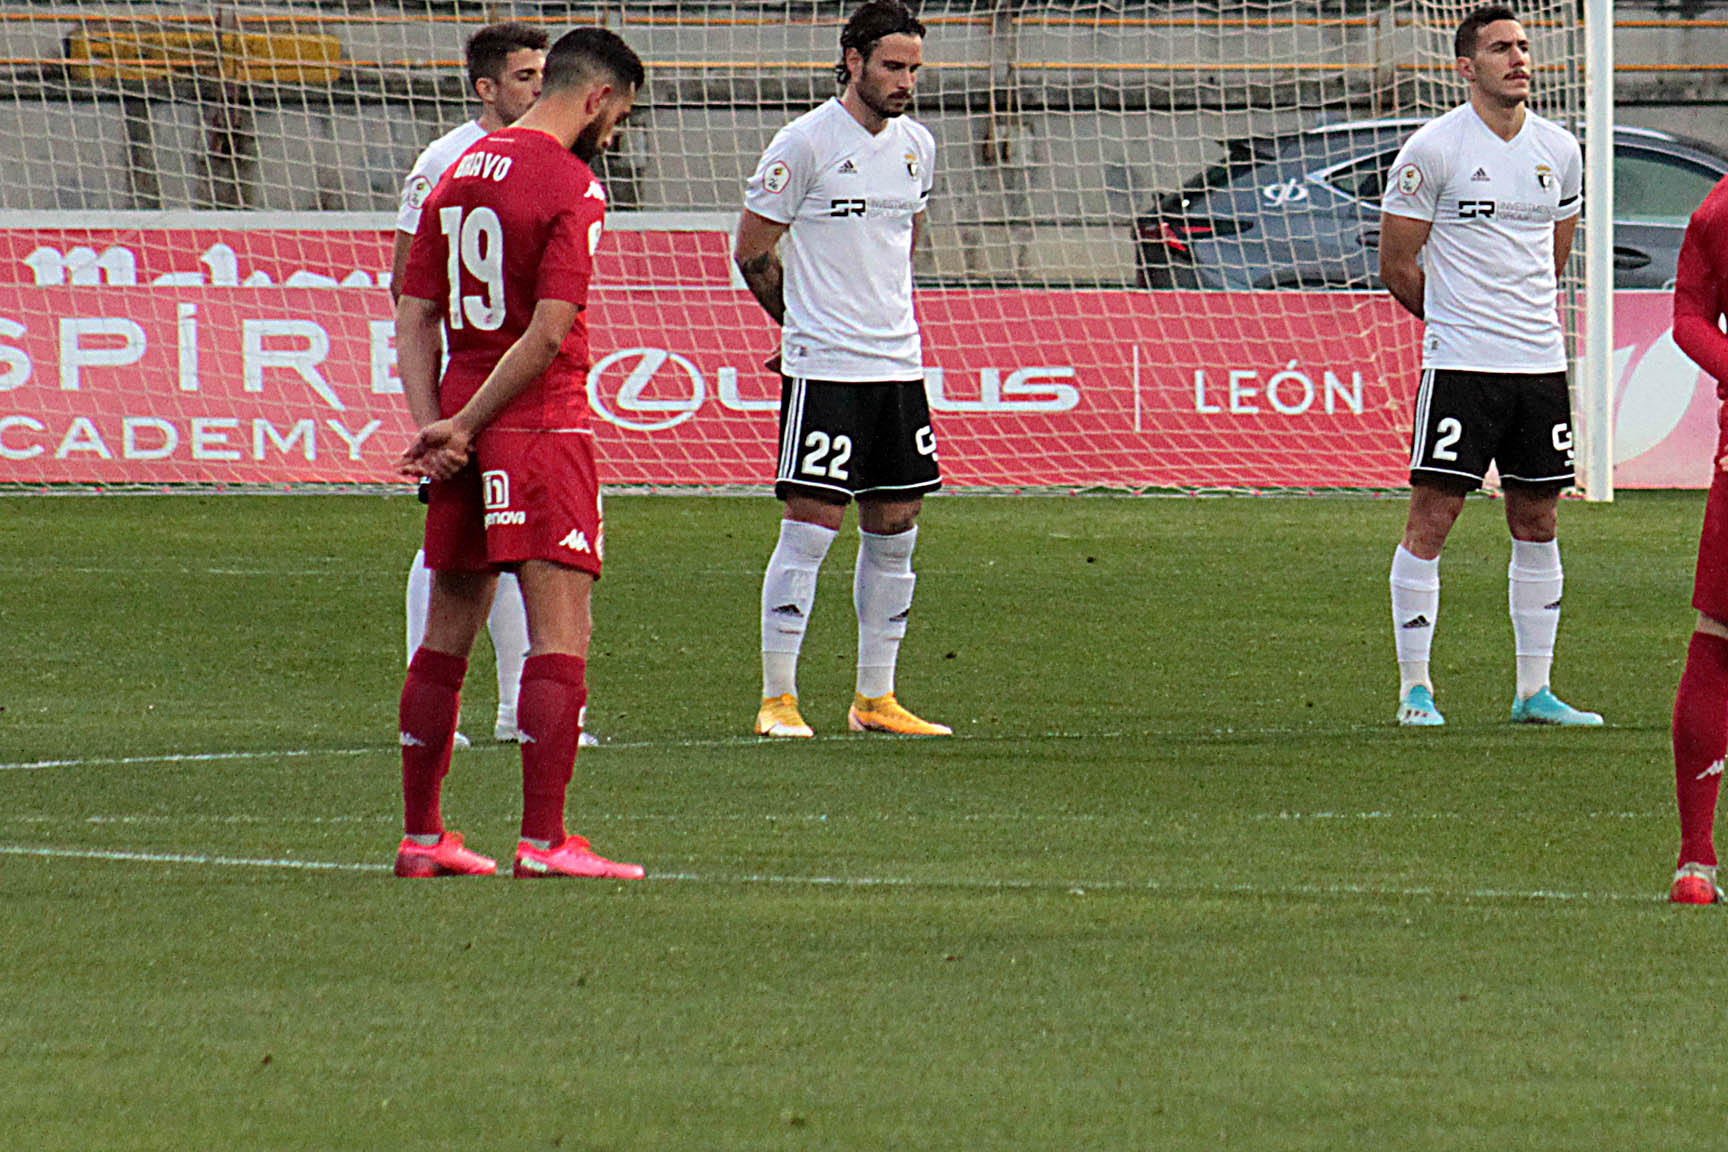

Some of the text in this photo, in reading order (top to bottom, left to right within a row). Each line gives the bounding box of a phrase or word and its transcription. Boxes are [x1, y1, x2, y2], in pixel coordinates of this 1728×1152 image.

[453, 151, 513, 182] BRAVO
[439, 206, 507, 330] 19
[718, 366, 1081, 412] LUS
[1194, 359, 1364, 415] LEÓN
[801, 430, 852, 481] 22
[1432, 417, 1462, 461] 2
